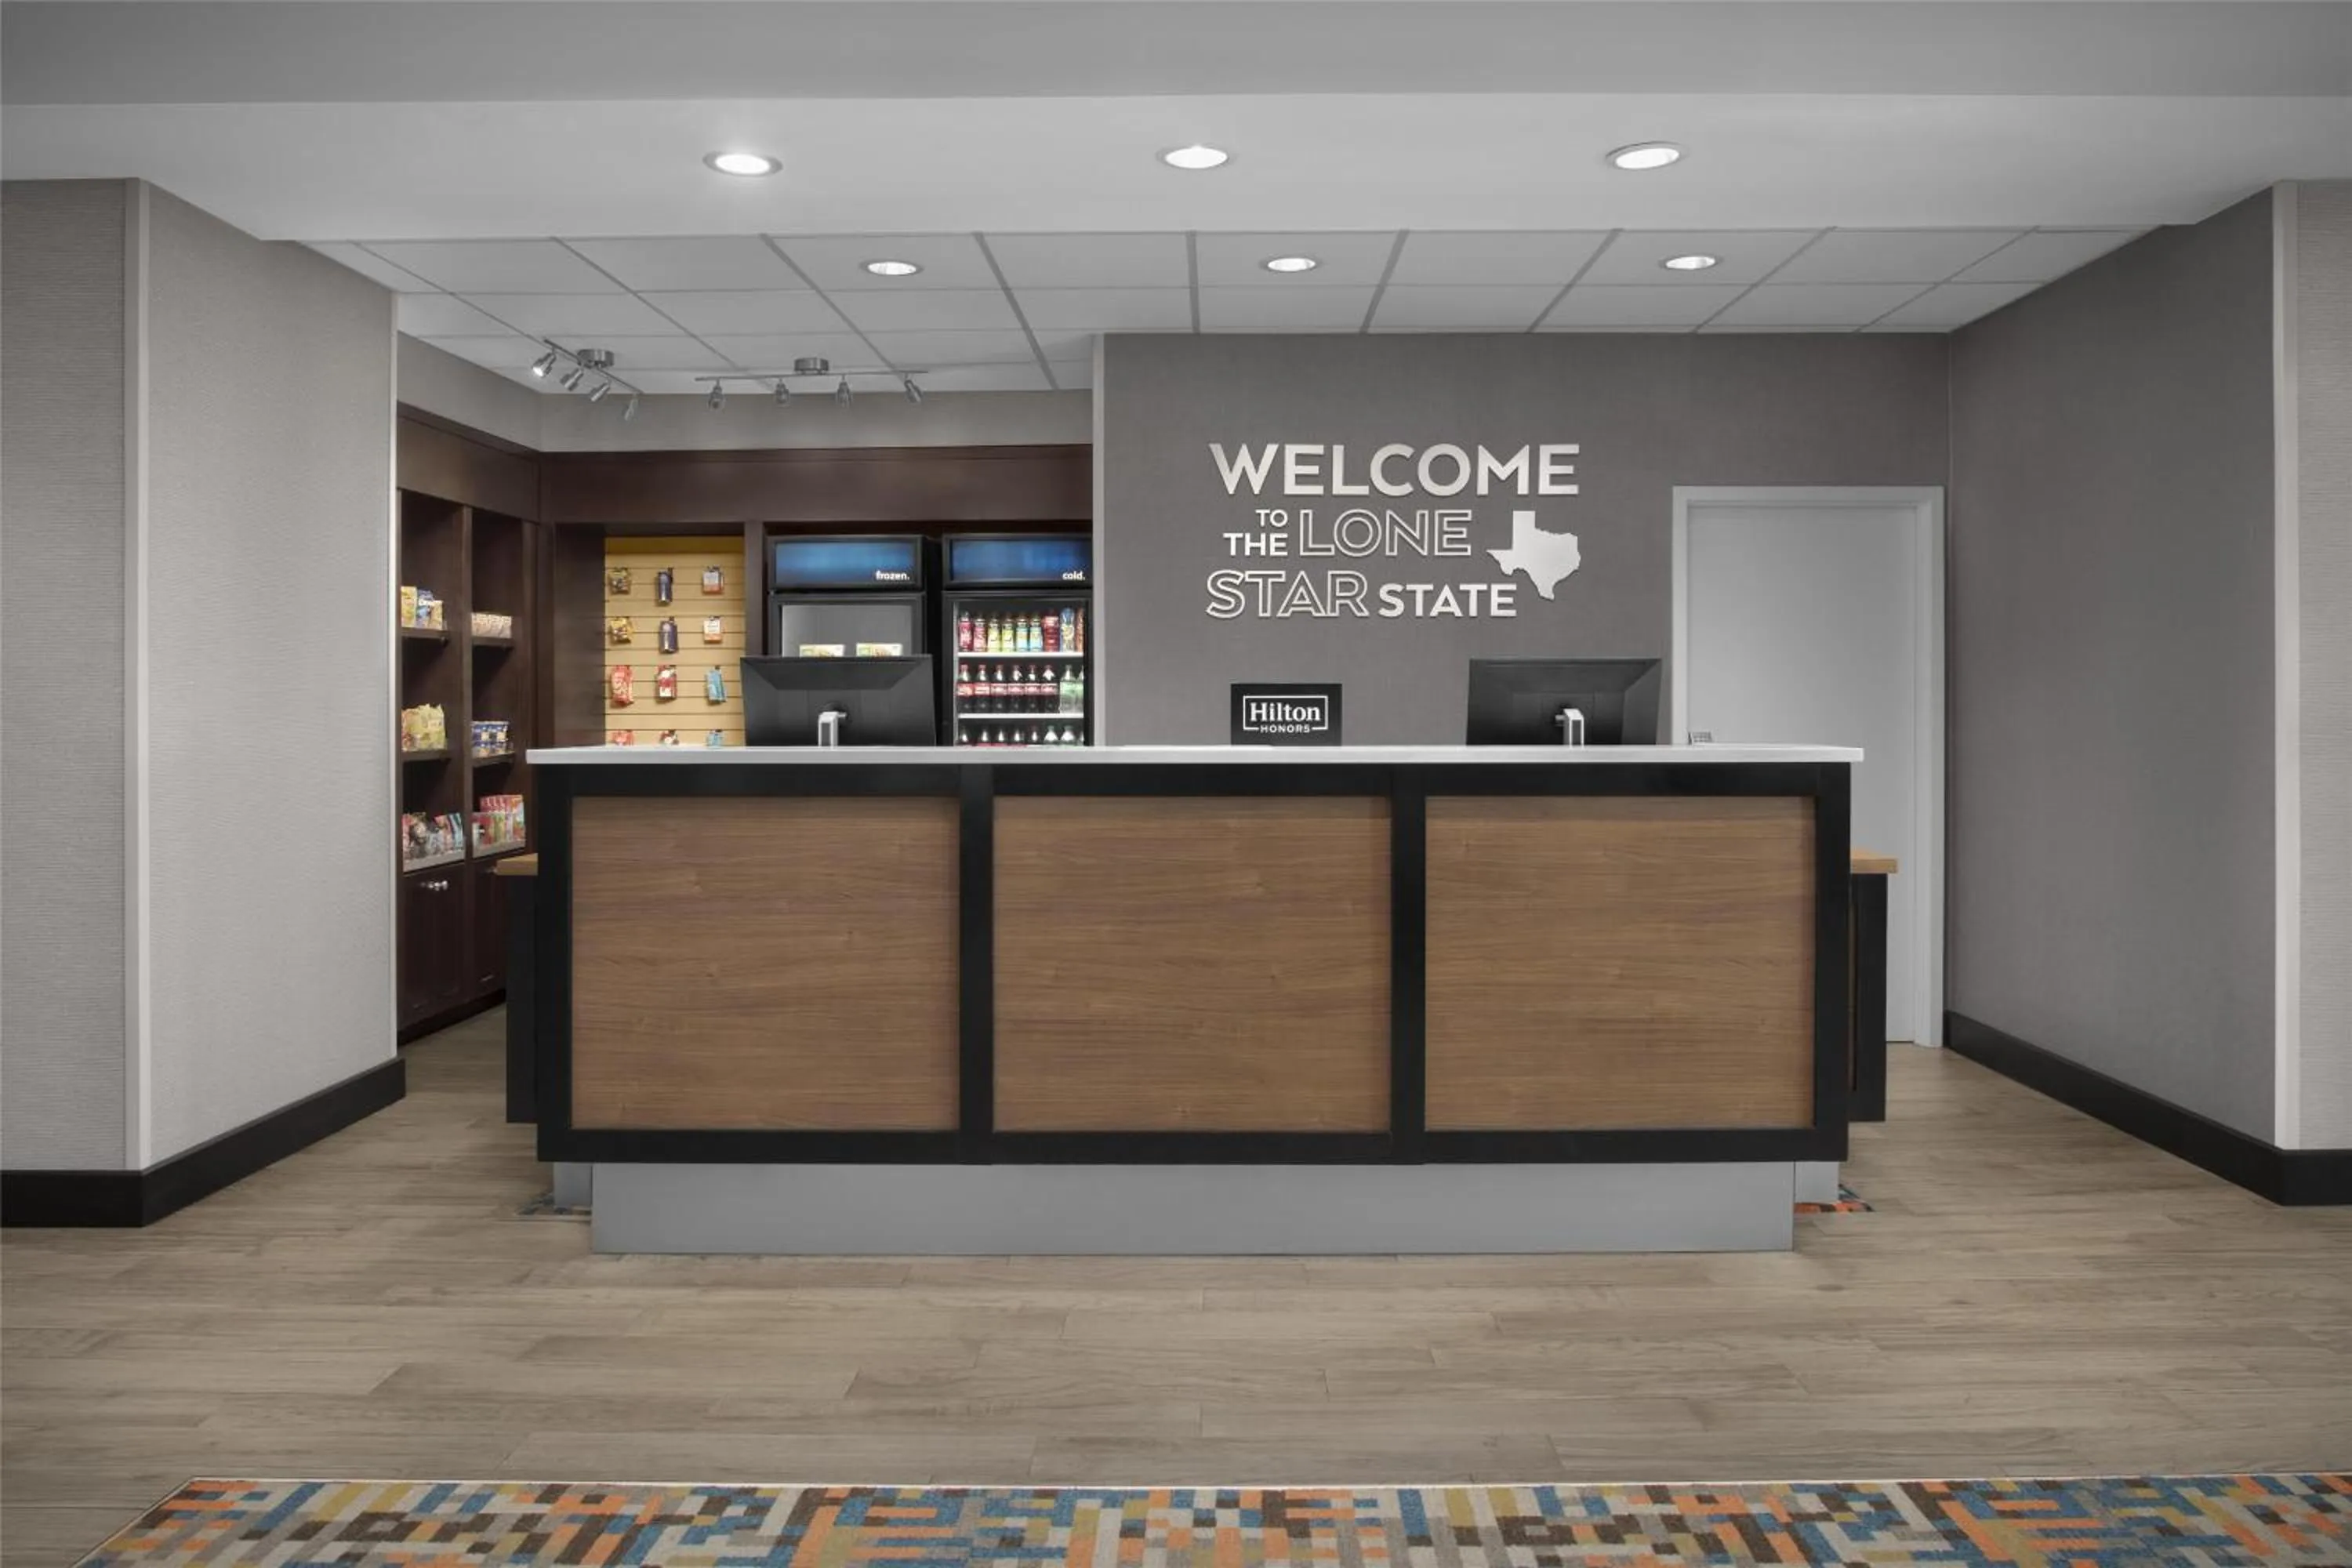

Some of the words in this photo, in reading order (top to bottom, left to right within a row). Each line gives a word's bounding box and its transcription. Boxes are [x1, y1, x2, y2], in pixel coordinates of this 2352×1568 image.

[1208, 444, 1580, 495] WELCOME
[1255, 509, 1288, 527] TO
[1223, 532, 1288, 556] THE
[1298, 509, 1472, 557] LONE
[876, 570, 909, 580] frozen.
[1206, 570, 1370, 618] STAR
[1378, 583, 1517, 617] STATE
[1250, 702, 1320, 722] Hilton
[1260, 724, 1310, 733] HONORS
